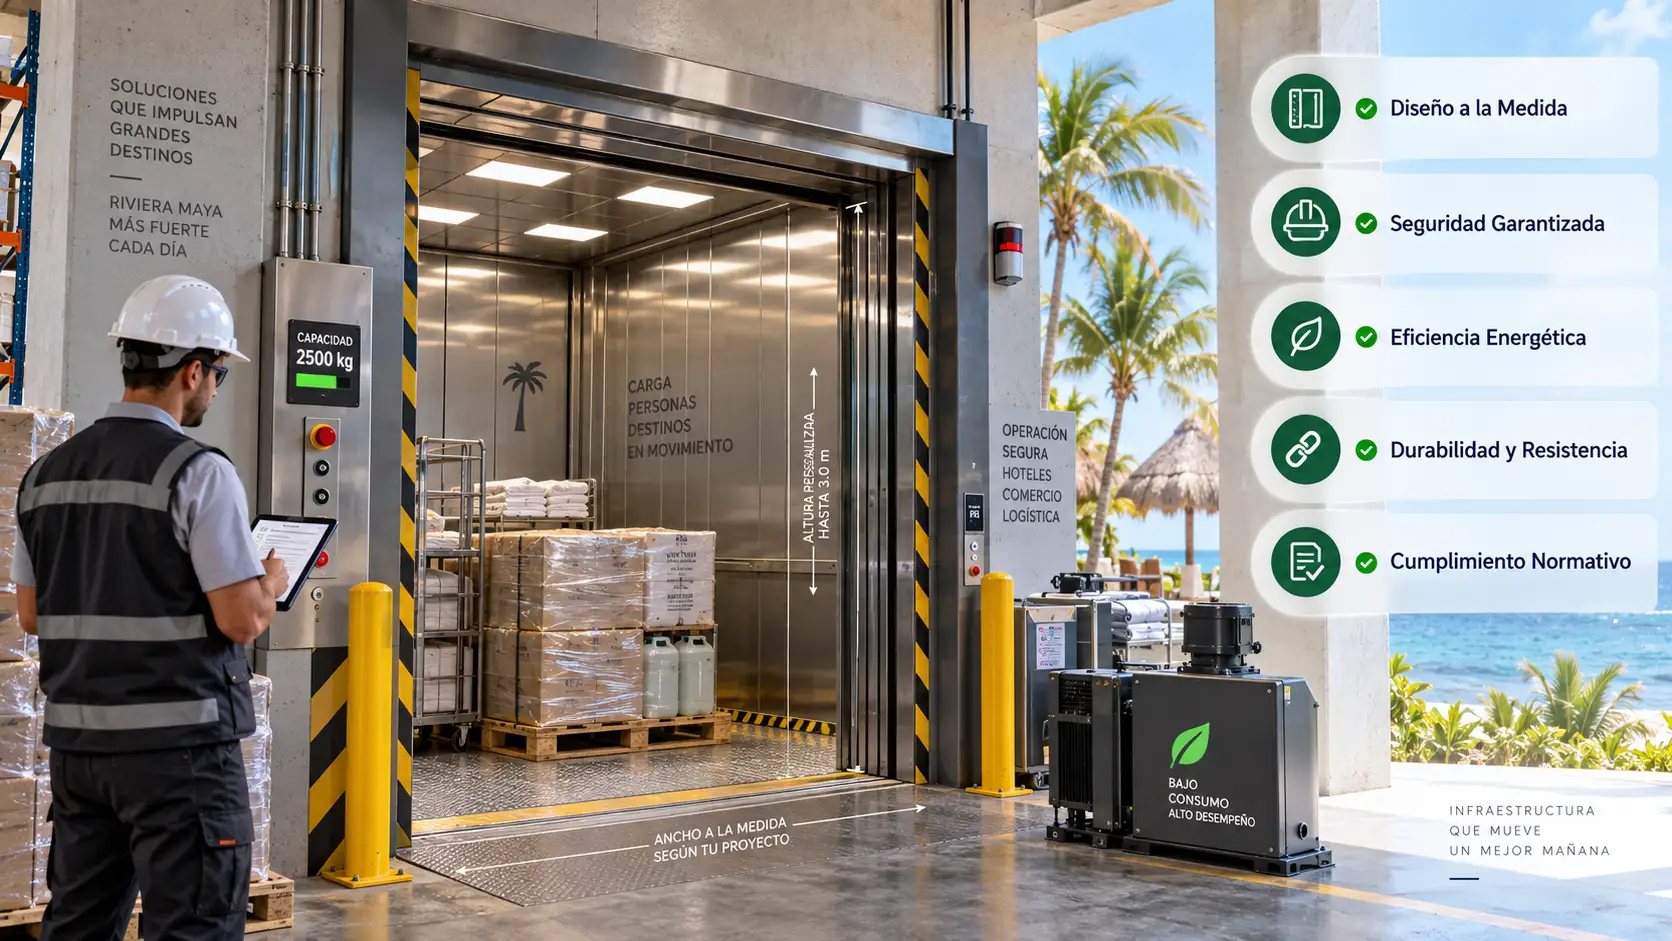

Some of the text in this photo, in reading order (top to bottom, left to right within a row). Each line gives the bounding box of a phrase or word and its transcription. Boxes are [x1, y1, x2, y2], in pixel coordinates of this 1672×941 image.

[110, 78, 217, 105] SOLUCIONES
[110, 100, 237, 129] QUE IMPULSAN
[110, 122, 190, 144] GRANDES
[110, 143, 193, 166] DESTINOS
[111, 196, 222, 218] RIVIERA MAYA
[110, 216, 209, 237] MÁS FUERTE
[109, 239, 187, 257] CADA DÍA
[297, 332, 353, 347] CAPACIDAD
[297, 350, 353, 372] 2500 kg
[628, 376, 671, 394] CARGA
[629, 395, 696, 415] PERSONAS
[628, 419, 691, 437] DESTINOS
[1003, 424, 1067, 441] OPERACIÓN
[628, 438, 733, 459] EN MOVIMIENTO
[1003, 445, 1048, 460] SEGURA
[1003, 467, 1051, 481] HOTELES
[1003, 488, 1061, 503] COMERCIO
[1003, 507, 1060, 523] LOGÍSTICA
[1169, 778, 1197, 789] BAJO
[1169, 793, 1230, 809] CONSUMO
[1169, 809, 1256, 828] ALTO DESEMPEÑO
